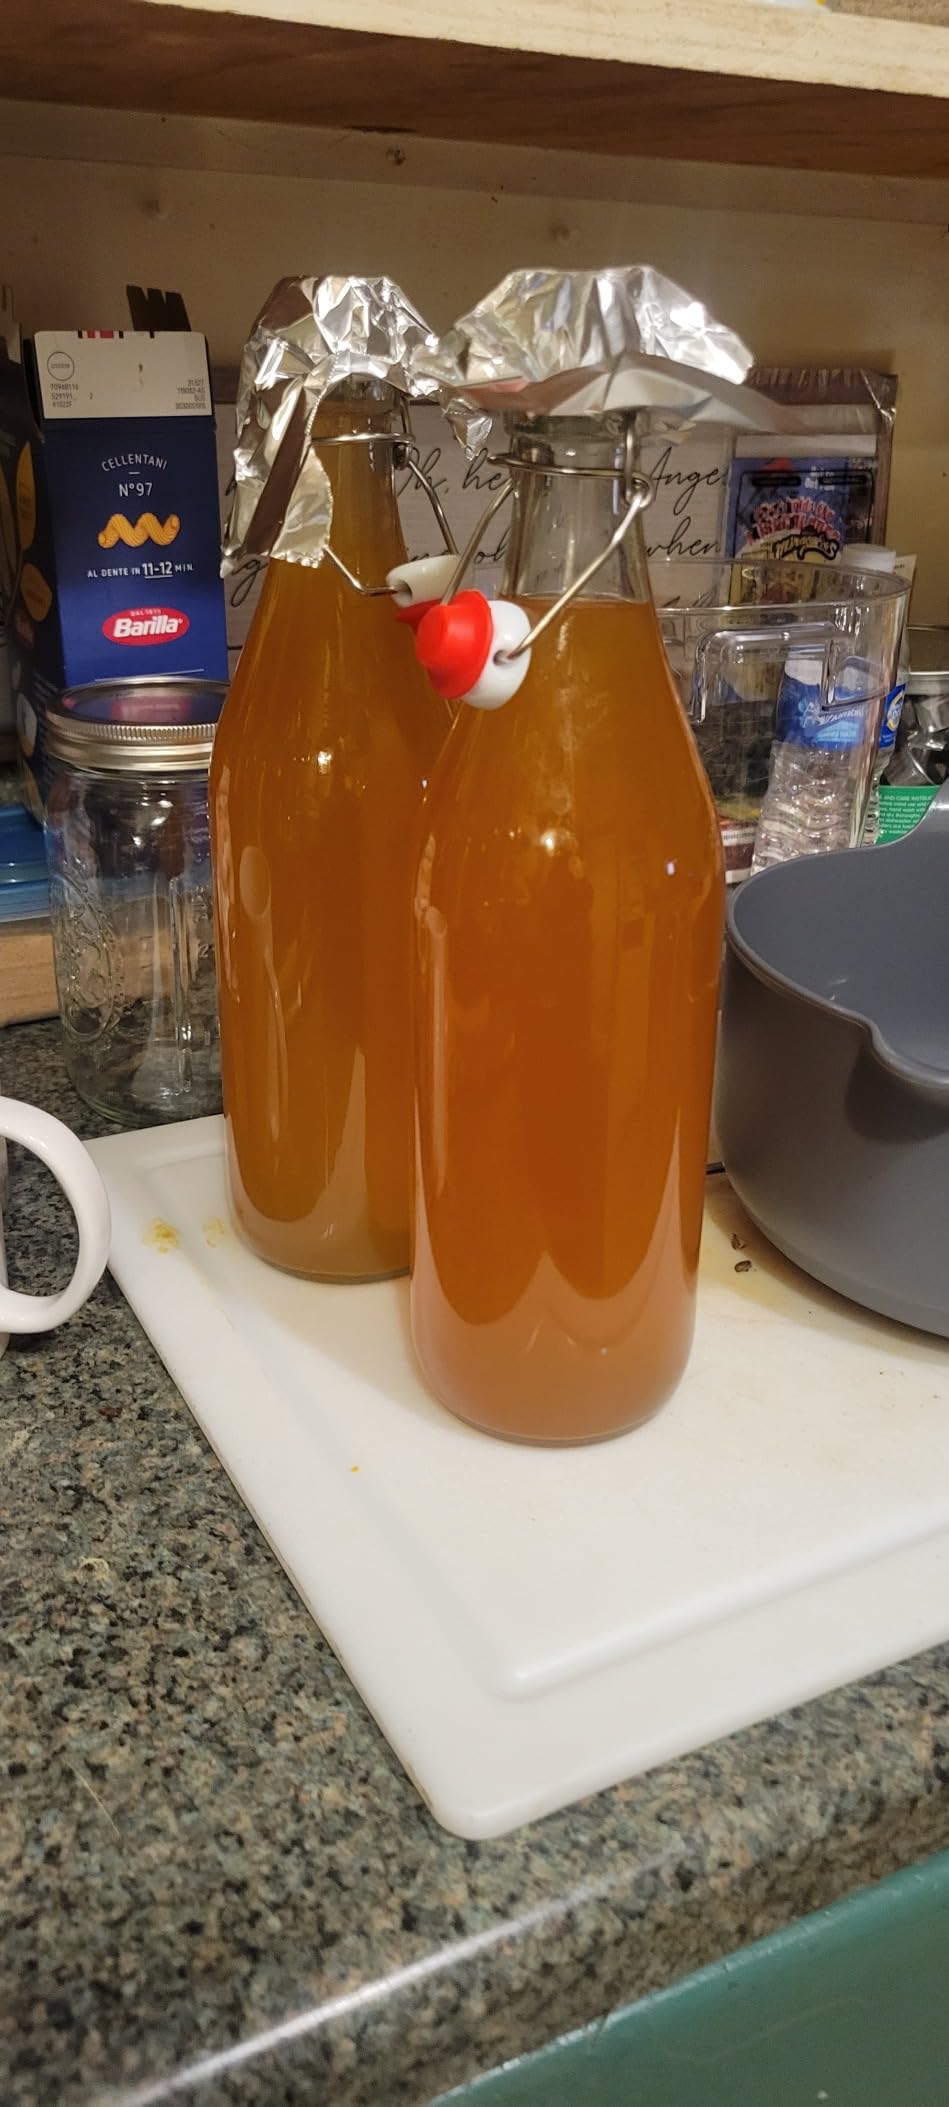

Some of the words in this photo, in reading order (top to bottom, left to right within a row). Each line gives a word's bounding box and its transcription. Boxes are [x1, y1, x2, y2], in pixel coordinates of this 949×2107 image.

[101, 453, 167, 471] CELLENTANI
[101, 568, 129, 577] DENTE
[131, 567, 140, 575] IN
[142, 561, 173, 576] 11-12
[113, 615, 180, 638] Barilla
